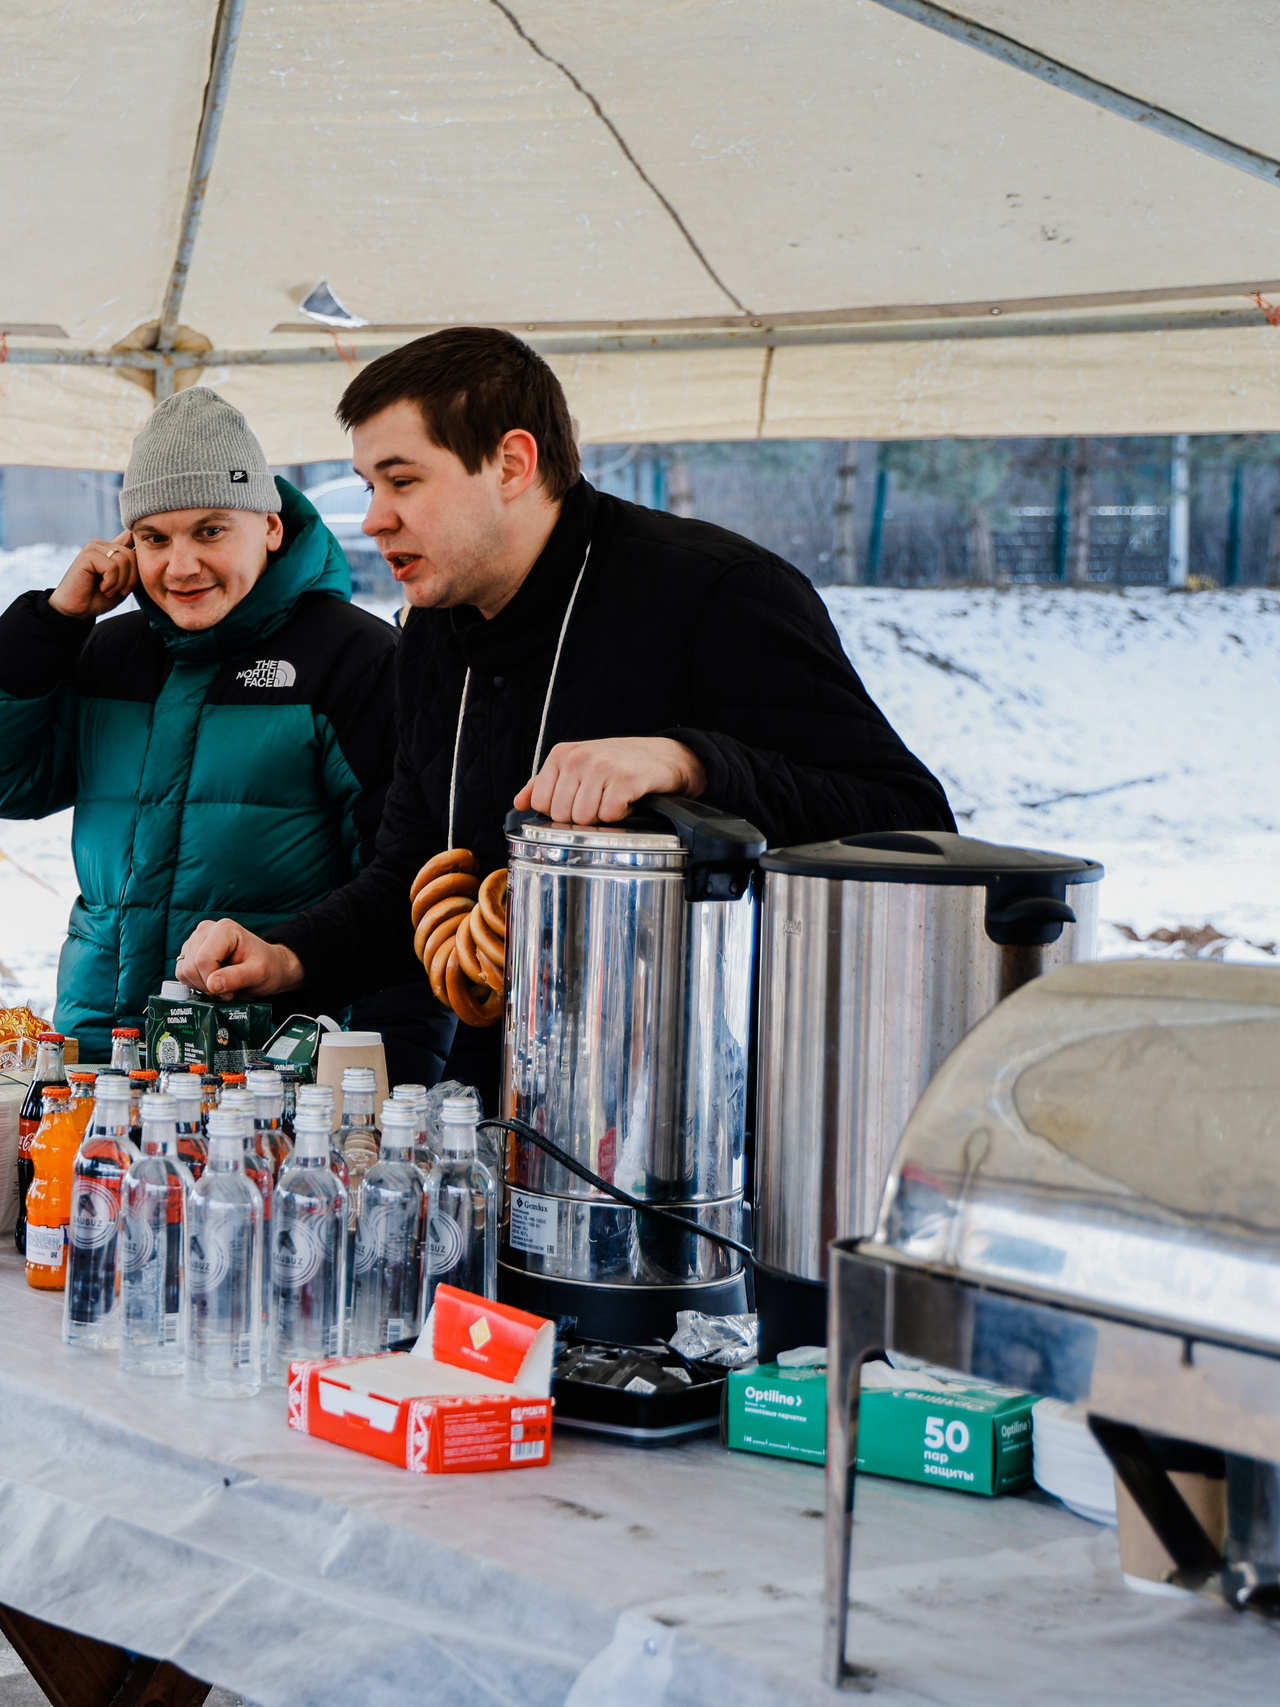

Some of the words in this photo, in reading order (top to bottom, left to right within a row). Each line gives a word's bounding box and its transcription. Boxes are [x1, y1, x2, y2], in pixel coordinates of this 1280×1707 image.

[255, 660, 277, 669] THE
[236, 668, 276, 680] NORTH
[244, 678, 273, 687] FACE
[524, 1200, 549, 1212] Gemlux
[744, 1385, 795, 1406] Optiline
[923, 1415, 970, 1453] 50
[1001, 1421, 1028, 1439] Optiline
[923, 1450, 949, 1465] пар
[923, 1463, 975, 1482] защиты
